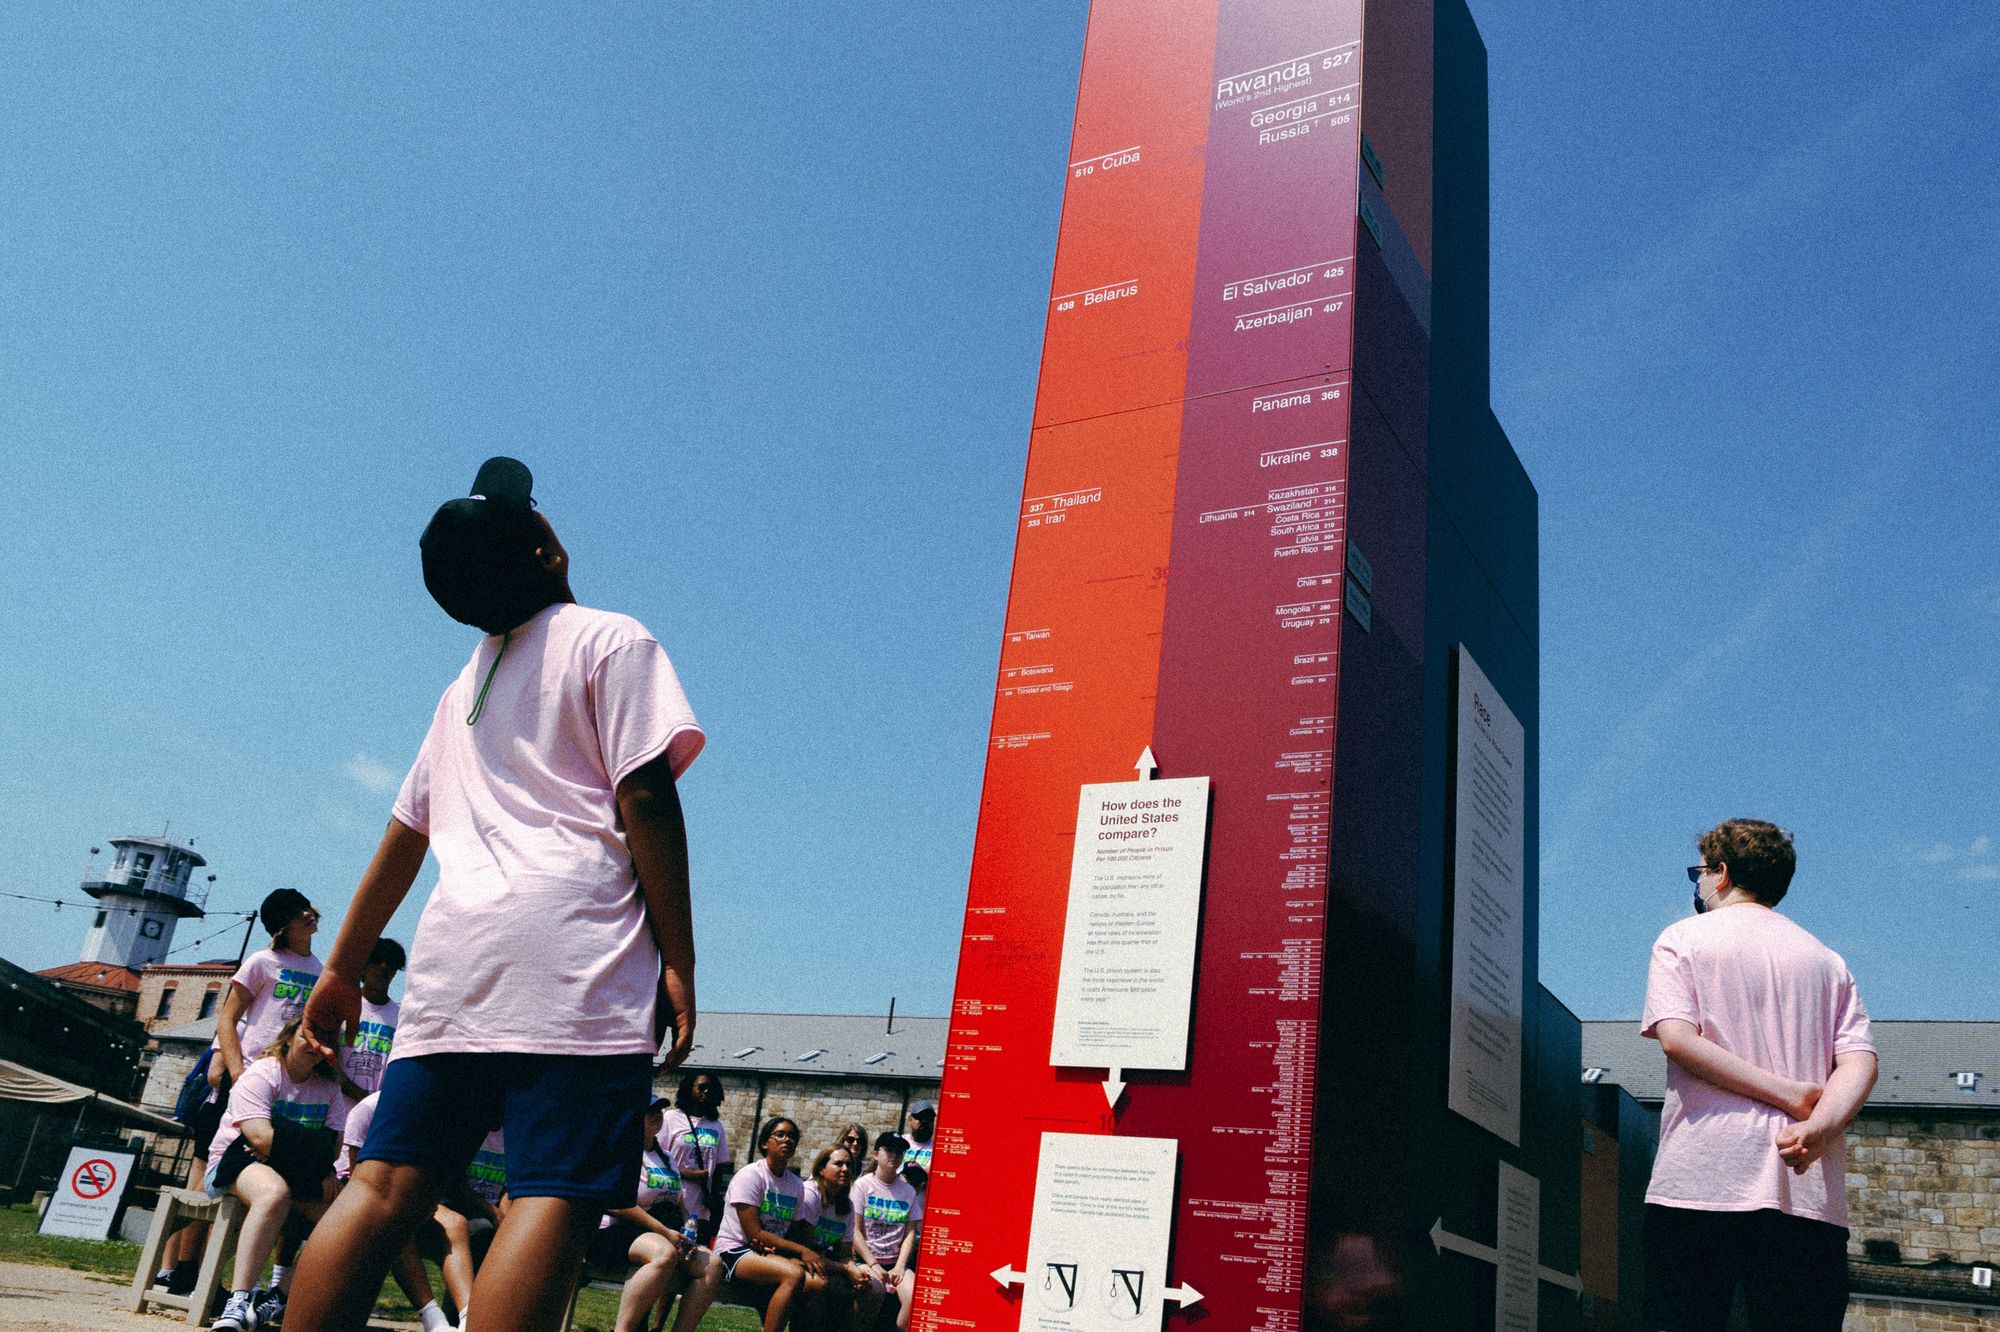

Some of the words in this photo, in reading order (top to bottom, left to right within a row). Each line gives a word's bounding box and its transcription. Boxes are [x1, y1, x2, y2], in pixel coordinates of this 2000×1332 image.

[1217, 62, 1311, 98] Rwanda
[1322, 51, 1352, 69] 527
[1254, 88, 1271, 101] 2nd
[1273, 77, 1312, 95] Highest)
[1250, 101, 1317, 127] Georgia
[1329, 93, 1350, 106] 514
[1259, 123, 1309, 144] Russia
[1330, 114, 1350, 126] 505
[1076, 166, 1093, 177] 510
[1102, 152, 1140, 170] Cuba
[1222, 286, 1237, 301] El
[1243, 271, 1312, 297] Salvador
[1323, 266, 1344, 278] 425
[1057, 301, 1074, 312] 438
[1084, 284, 1138, 306] Belarus
[1234, 305, 1313, 332] Azerbaijan
[1323, 302, 1343, 313] 407
[1252, 392, 1311, 413] Panama
[1321, 389, 1340, 401] 366
[1260, 450, 1311, 467] Ukraine
[1320, 447, 1337, 458] 338
[1268, 487, 1319, 501] Kazakhstan
[1030, 504, 1044, 513] 337
[1052, 491, 1101, 510] Thailand
[1045, 513, 1066, 525] Iran
[1199, 510, 1238, 524] Lithuania
[1266, 499, 1312, 513] Swaziland
[1275, 514, 1299, 524] Costa
[1301, 511, 1320, 521] Rica
[1271, 526, 1294, 537] South
[1296, 522, 1320, 533] Africa
[1296, 535, 1319, 544] Latvia
[1274, 548, 1299, 558] Puerto
[1301, 546, 1318, 555] Rico
[1296, 579, 1317, 588] Chile
[1275, 605, 1311, 616] Mongolia
[1281, 617, 1314, 629] Uruguay
[1025, 630, 1050, 640] Taiwan
[1294, 655, 1315, 665] Brazil
[1101, 800, 1126, 811] How
[1130, 799, 1159, 810] does
[1163, 798, 1181, 808] the
[1100, 814, 1138, 826] United
[1141, 813, 1178, 824] States
[1098, 827, 1157, 841] compare?
[274, 982, 300, 1000] BY
[867, 1195, 910, 1212] SAVED
[863, 1206, 883, 1220] BY
